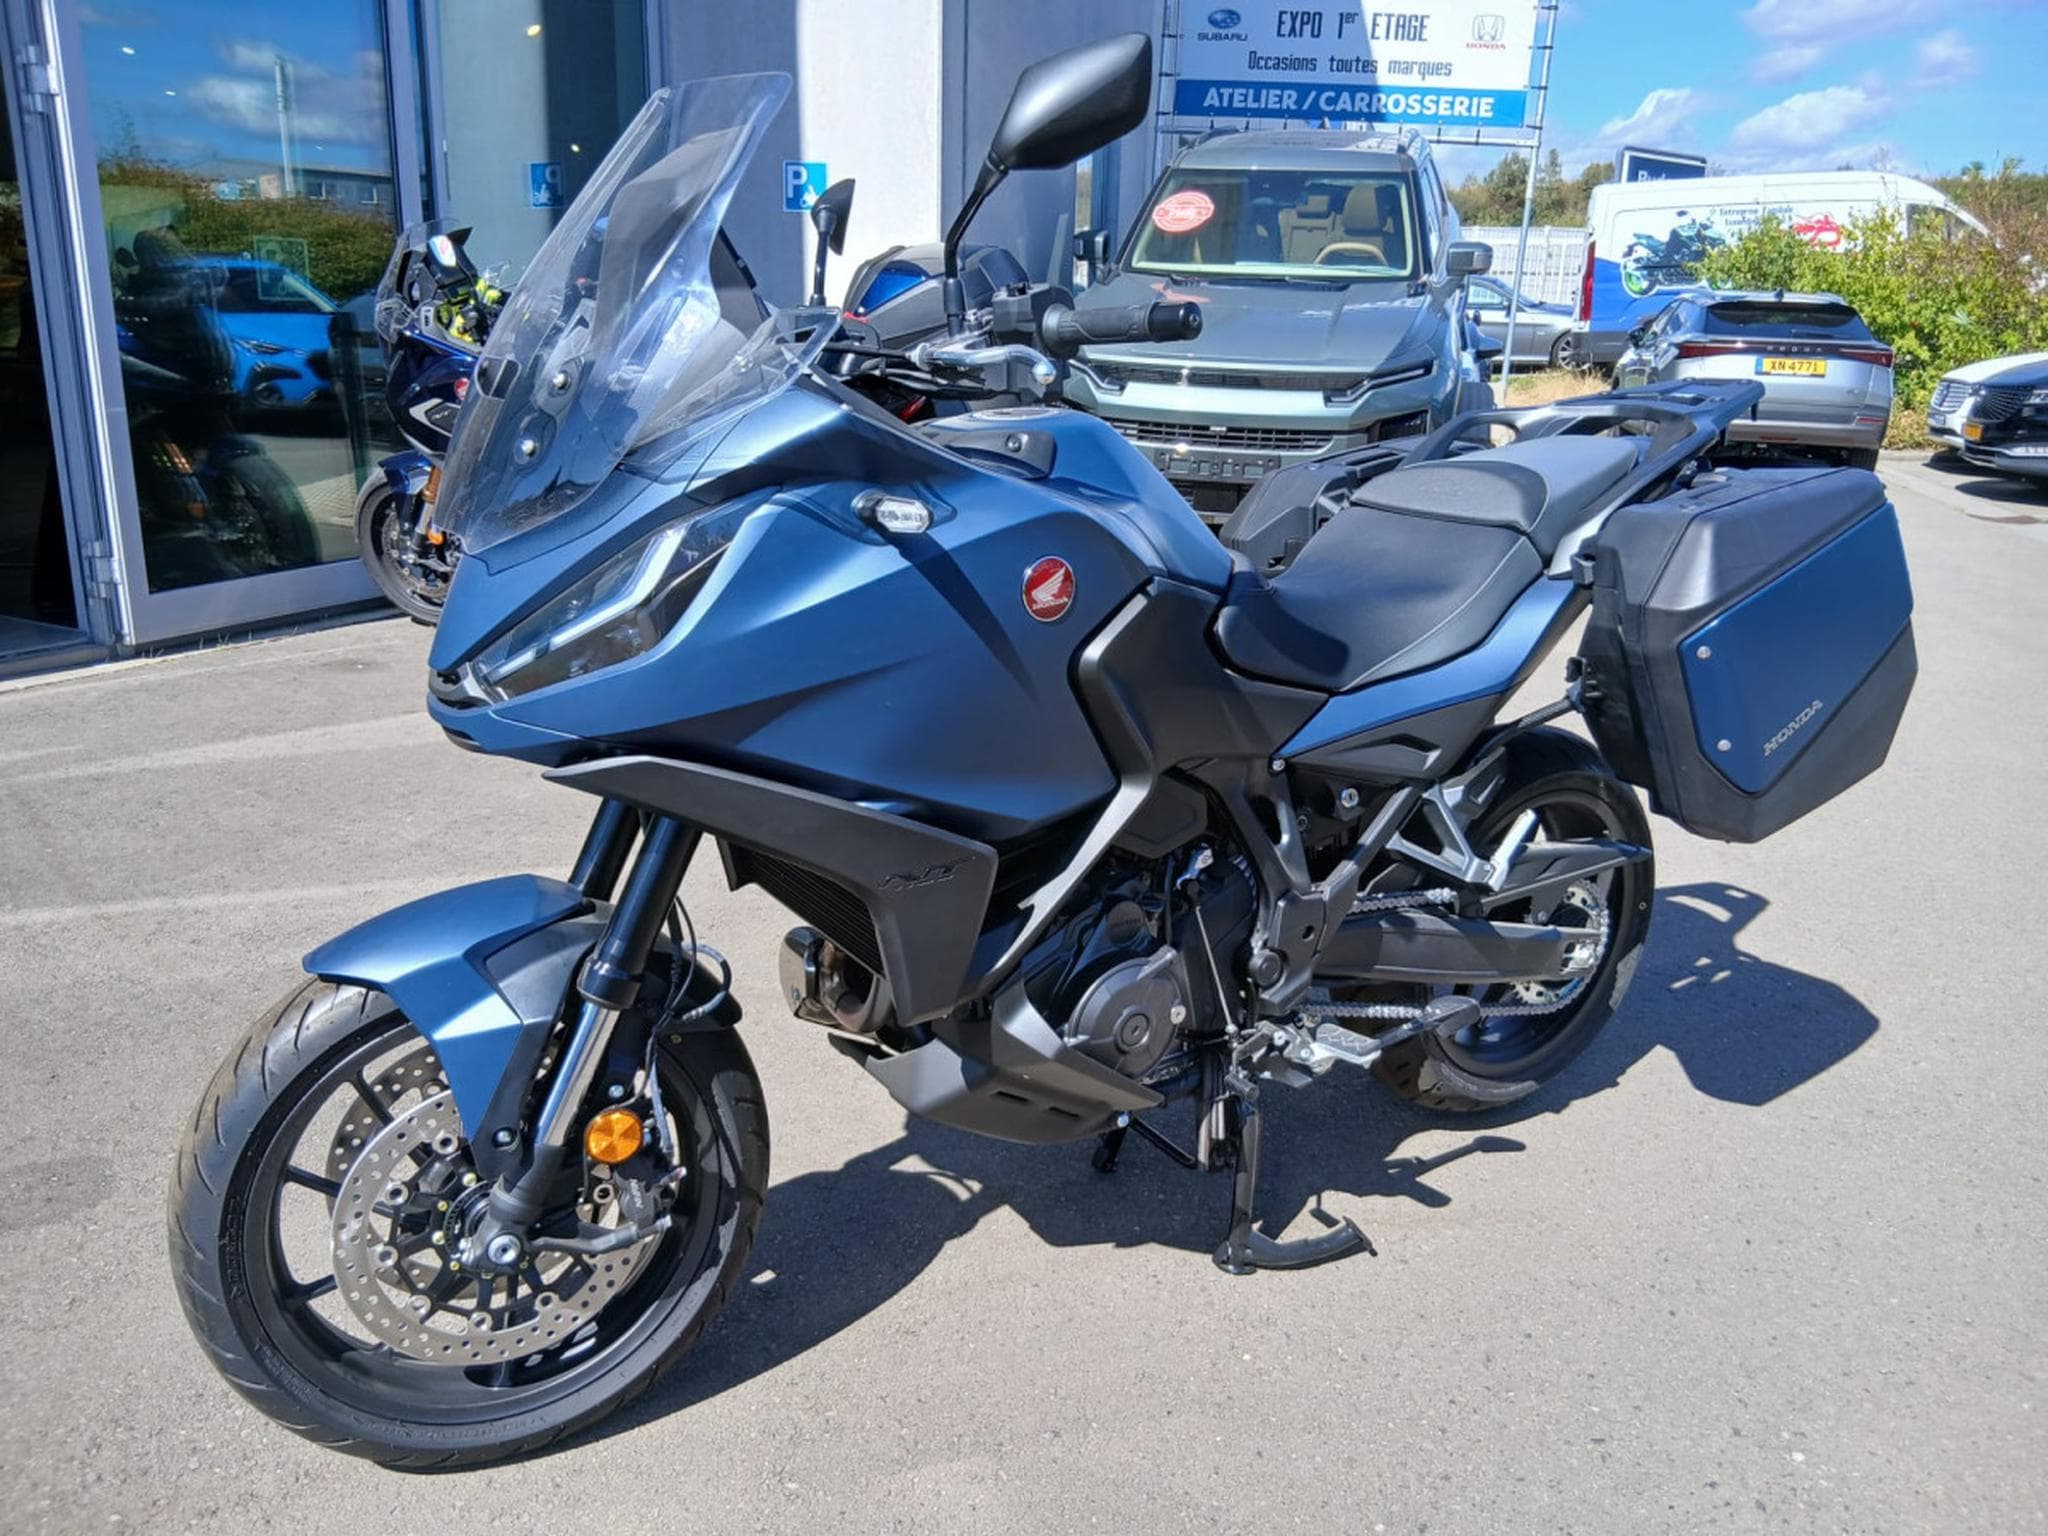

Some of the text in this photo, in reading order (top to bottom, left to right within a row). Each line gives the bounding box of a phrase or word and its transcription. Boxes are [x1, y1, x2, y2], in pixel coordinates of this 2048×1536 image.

[1197, 32, 1249, 42] SUBARU
[1276, 10, 1323, 39] EXPO
[1370, 12, 1430, 42] ETAGE
[1465, 42, 1507, 50] HONDA
[1248, 50, 1453, 81] Occasions toutes marques
[1202, 86, 1298, 110] ATELIER
[1318, 91, 1495, 118] CARROSSERIE
[787, 165, 808, 199] P
[1762, 699, 1824, 757] HONDA
